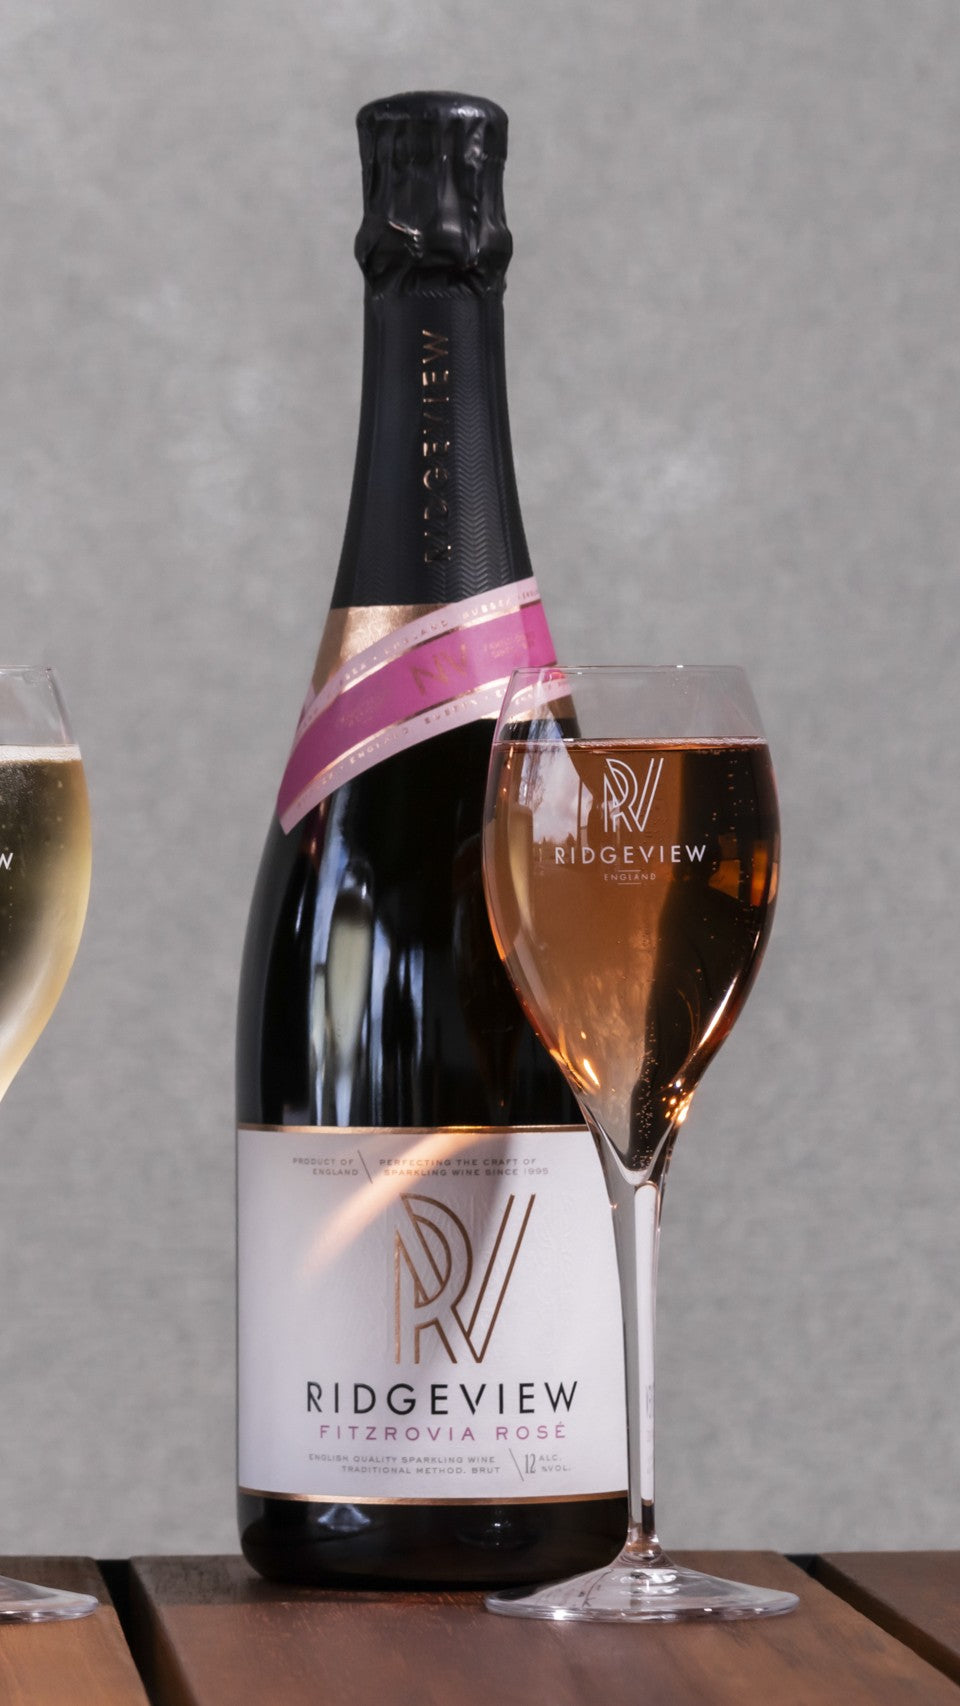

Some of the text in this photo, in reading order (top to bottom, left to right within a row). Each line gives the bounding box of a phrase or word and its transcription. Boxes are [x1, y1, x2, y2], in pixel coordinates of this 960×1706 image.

[554, 844, 707, 865] RIDGEVIEW
[603, 872, 657, 882] ENGLAND
[292, 1157, 354, 1166] PRODUCT OF
[379, 1158, 537, 1167] PERFECTING THE CRAFT OF
[312, 1168, 359, 1176] ENGLAND
[383, 1167, 549, 1177] SPARKLING WINE SINCE 1995
[306, 1380, 578, 1416] RIDGEVIEW
[319, 1421, 567, 1441] FITZROVIA ROSÉ
[308, 1453, 496, 1464] ENGLISH QUALITY SPARKLING WINE
[524, 1453, 537, 1474] 12
[341, 1465, 412, 1474] TRADITIONAL
[471, 1466, 502, 1474] BRUT
